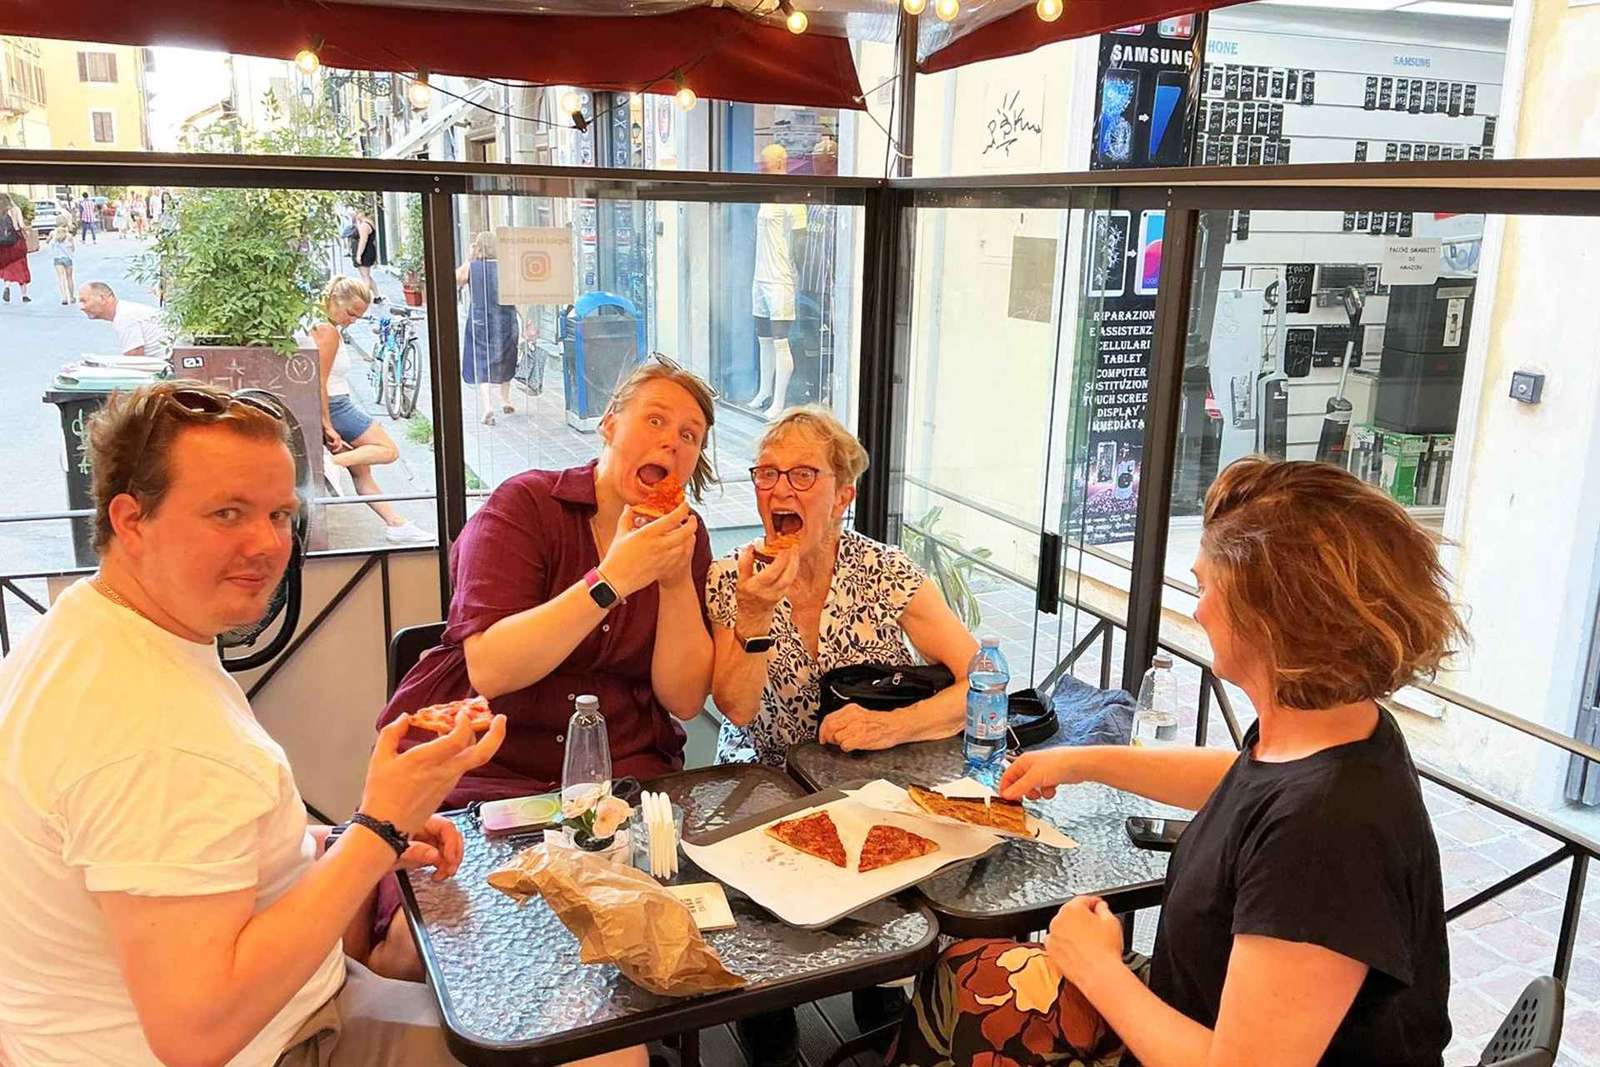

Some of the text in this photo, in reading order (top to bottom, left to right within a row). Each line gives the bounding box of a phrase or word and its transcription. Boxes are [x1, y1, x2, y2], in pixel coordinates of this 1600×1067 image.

[1111, 44, 1193, 65] SAMSUNG
[1393, 56, 1431, 68] SAMSUNG
[1098, 340, 1151, 351] CELLULARI
[1103, 353, 1143, 364] TABLET
[1096, 367, 1147, 378] COMPUTER
[1097, 405, 1140, 417] DISPLAY
